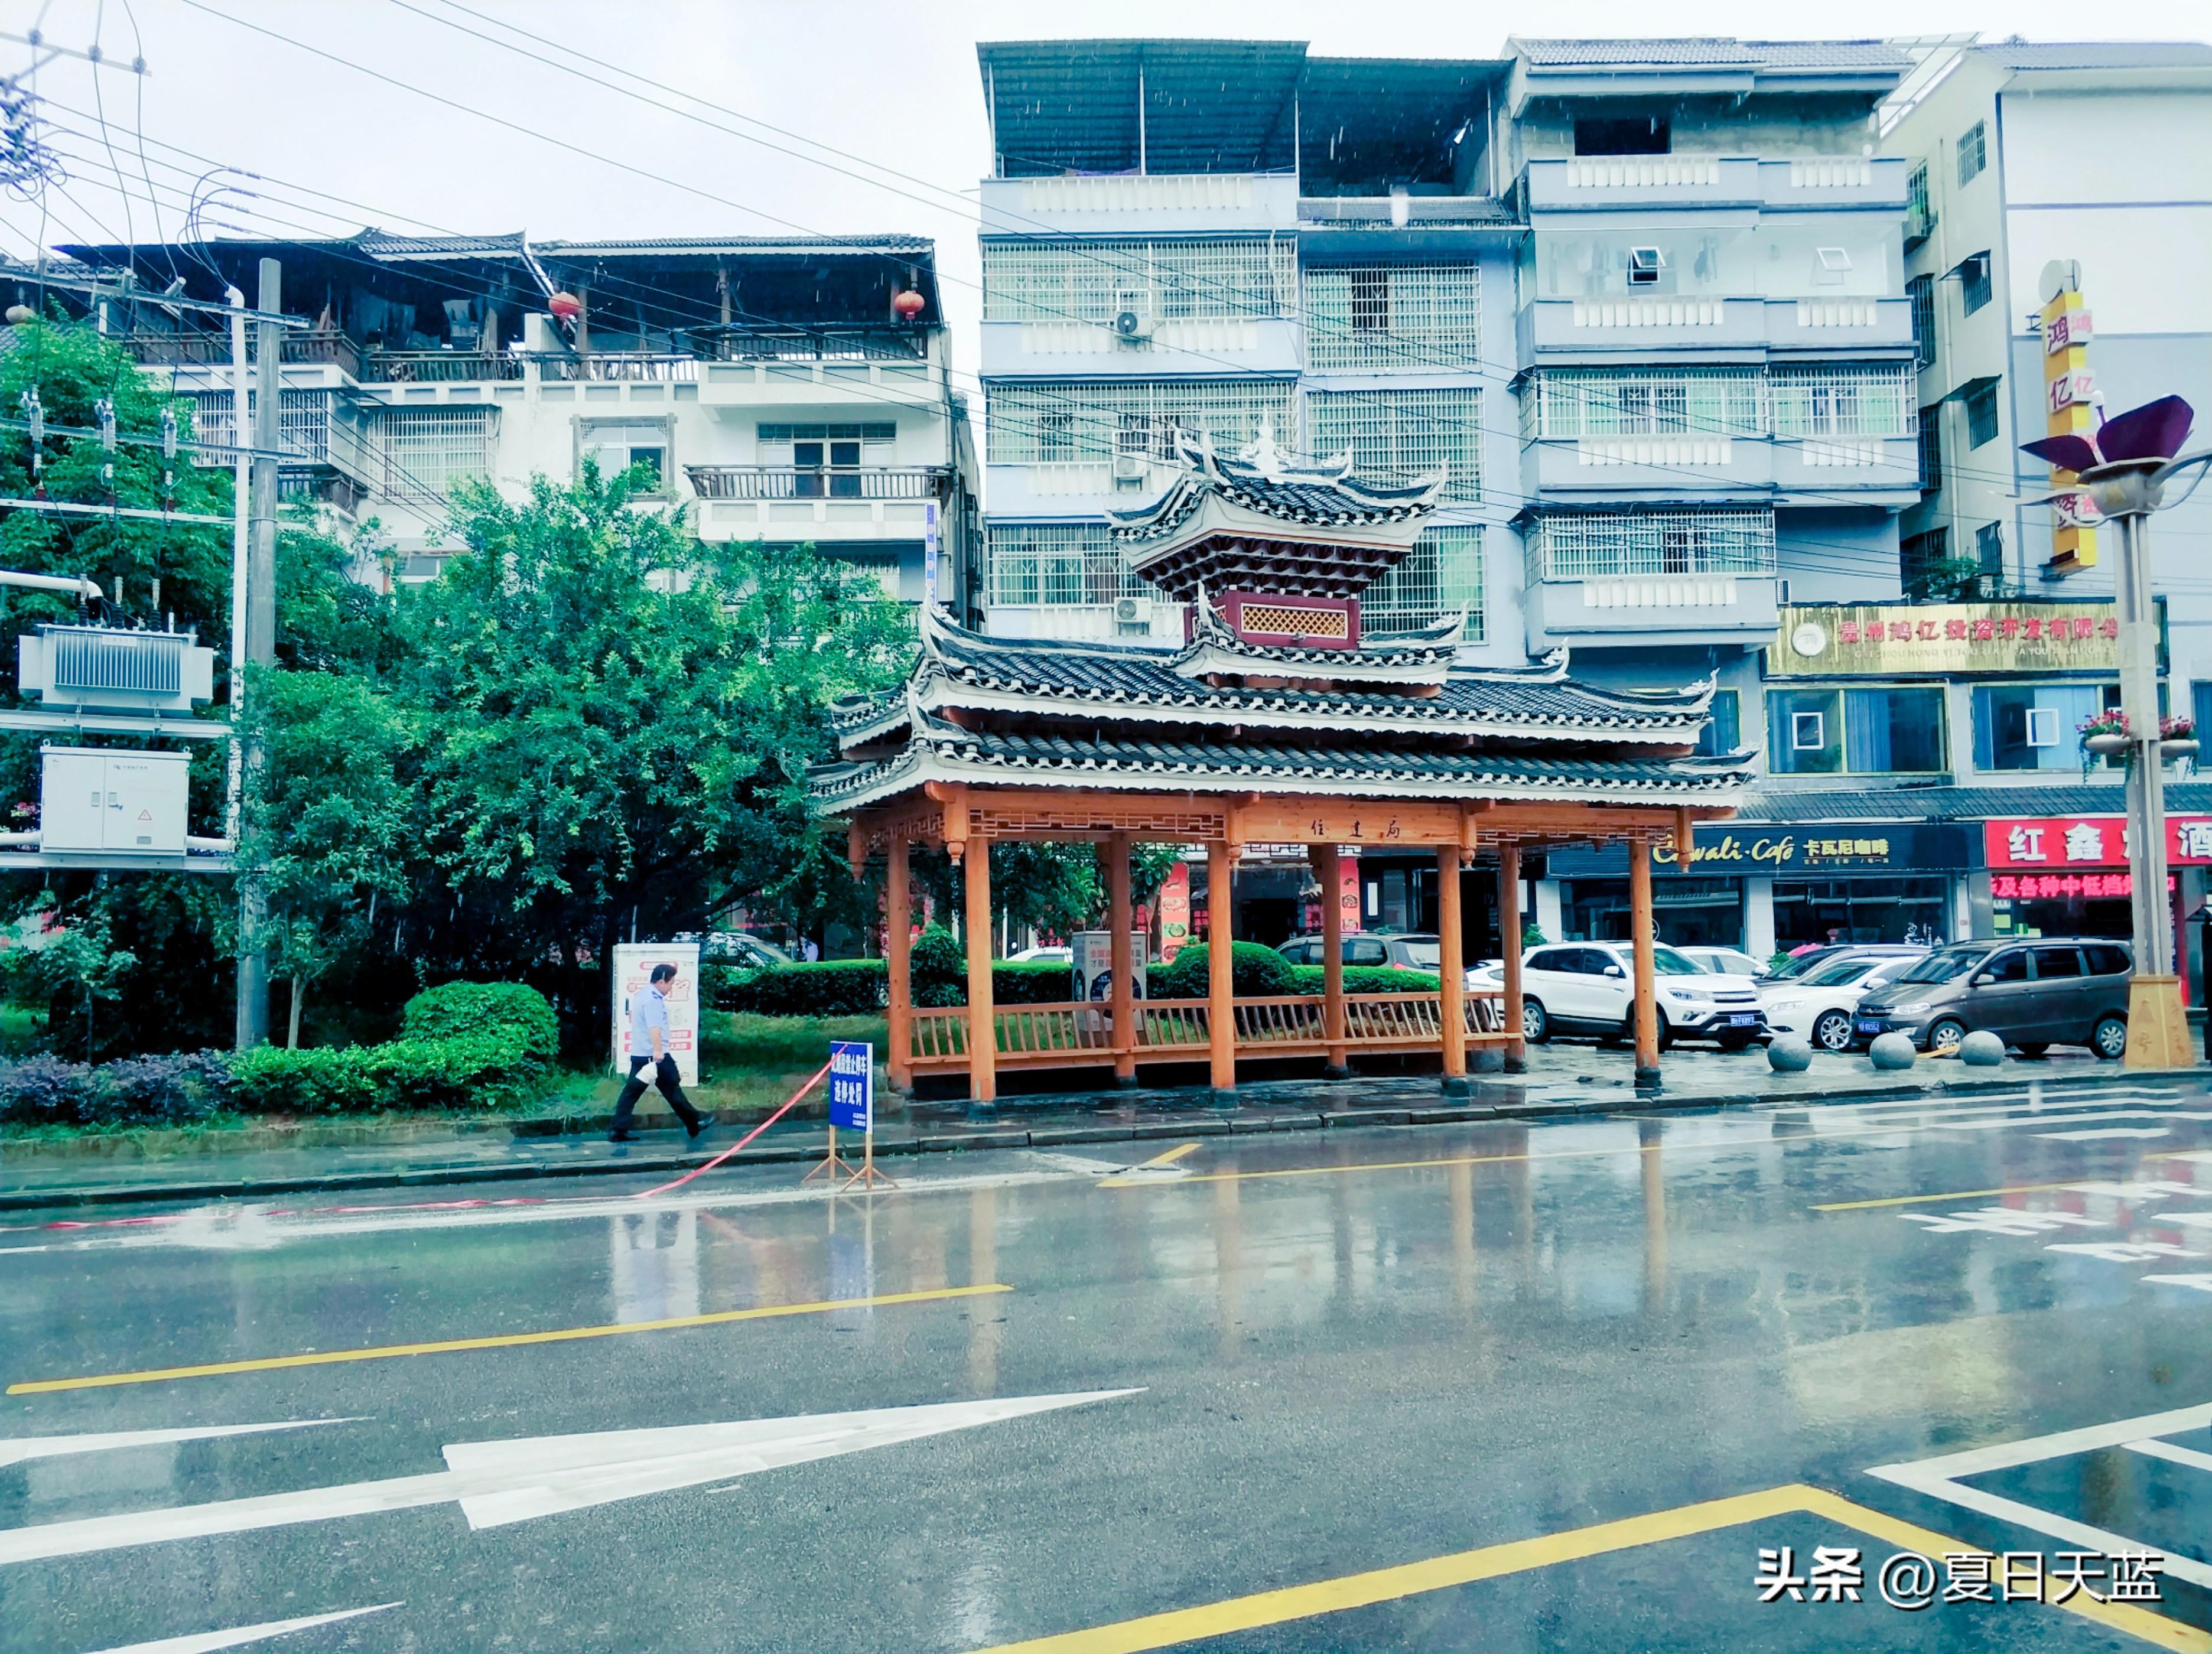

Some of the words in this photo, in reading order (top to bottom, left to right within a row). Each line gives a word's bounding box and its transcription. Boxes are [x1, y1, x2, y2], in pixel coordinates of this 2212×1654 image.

[1801, 839, 1889, 857] 卡瓦尼咖啡
[2009, 822, 2212, 861] 红鑫酒
[1990, 874, 2175, 897] 及各种中低档
